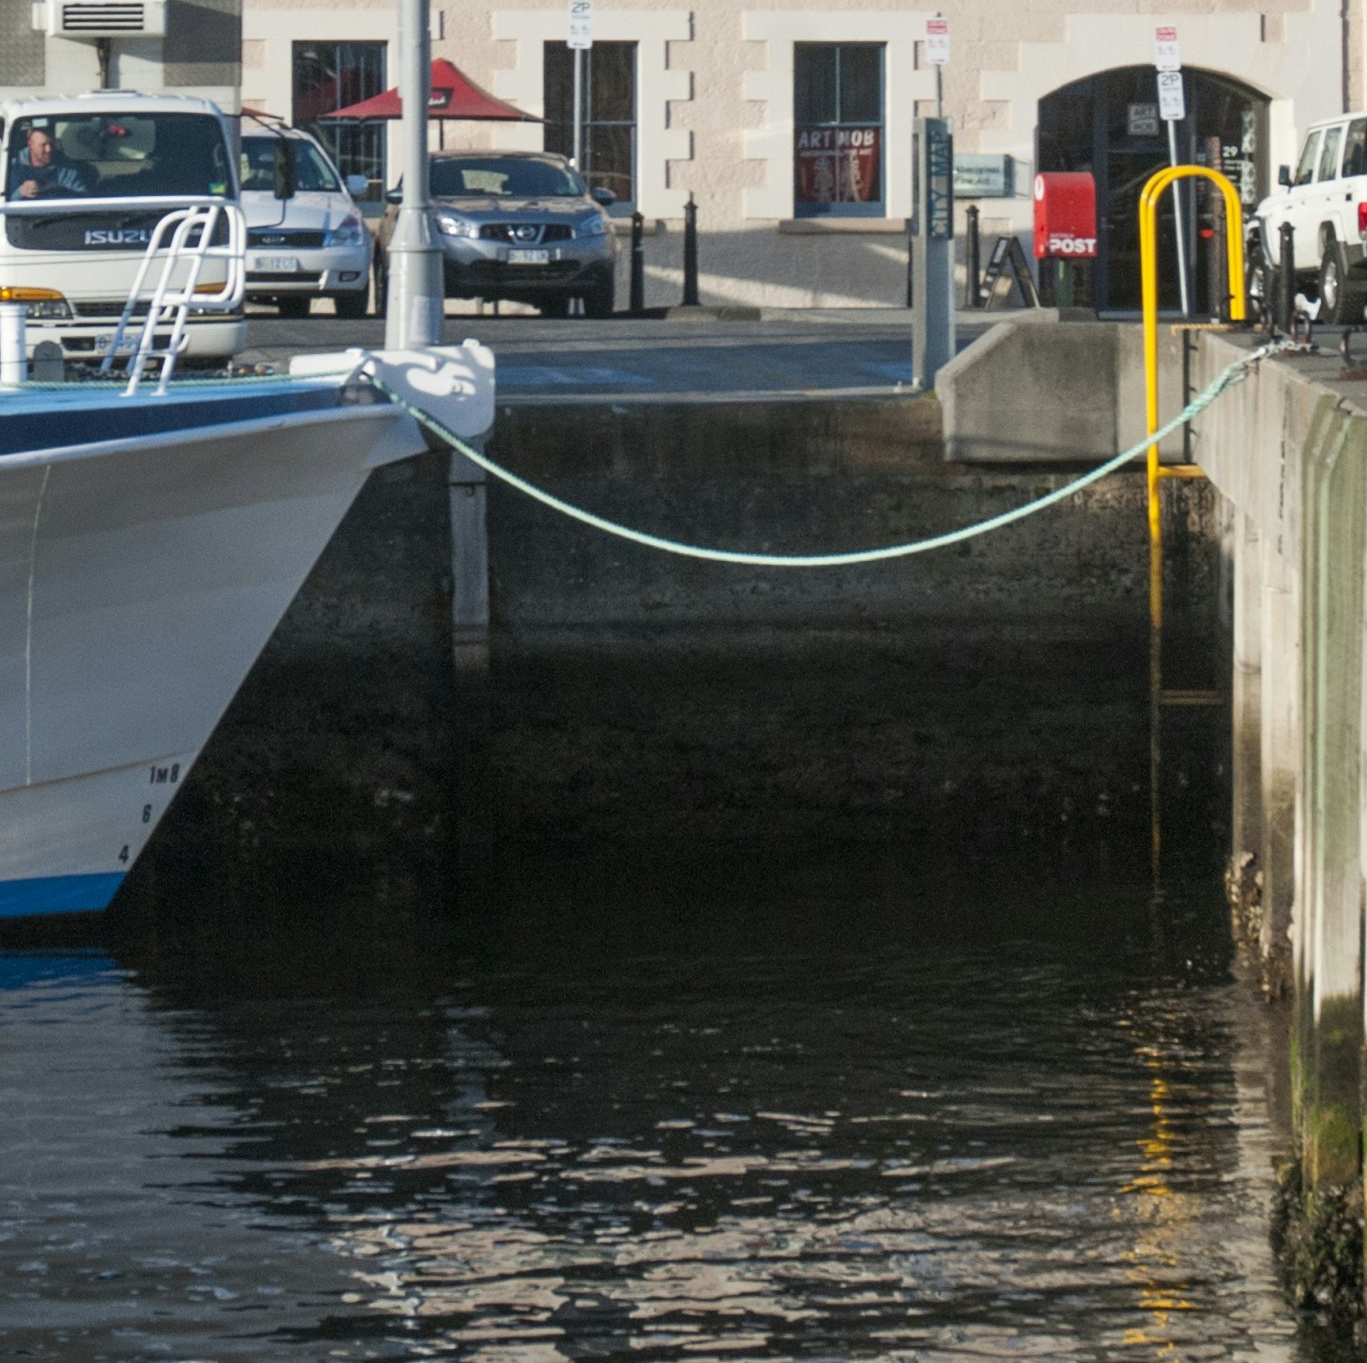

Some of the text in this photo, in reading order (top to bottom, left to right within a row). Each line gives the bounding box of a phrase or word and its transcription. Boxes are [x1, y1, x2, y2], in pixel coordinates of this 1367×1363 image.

[571, 2, 591, 13] 2P
[1161, 75, 1180, 86] 2P
[798, 130, 832, 148] ART
[1223, 145, 1239, 157] 29
[931, 188, 948, 237] CITY
[1050, 238, 1097, 253] POST
[142, 804, 152, 823] 6
[119, 845, 129, 863] 4
